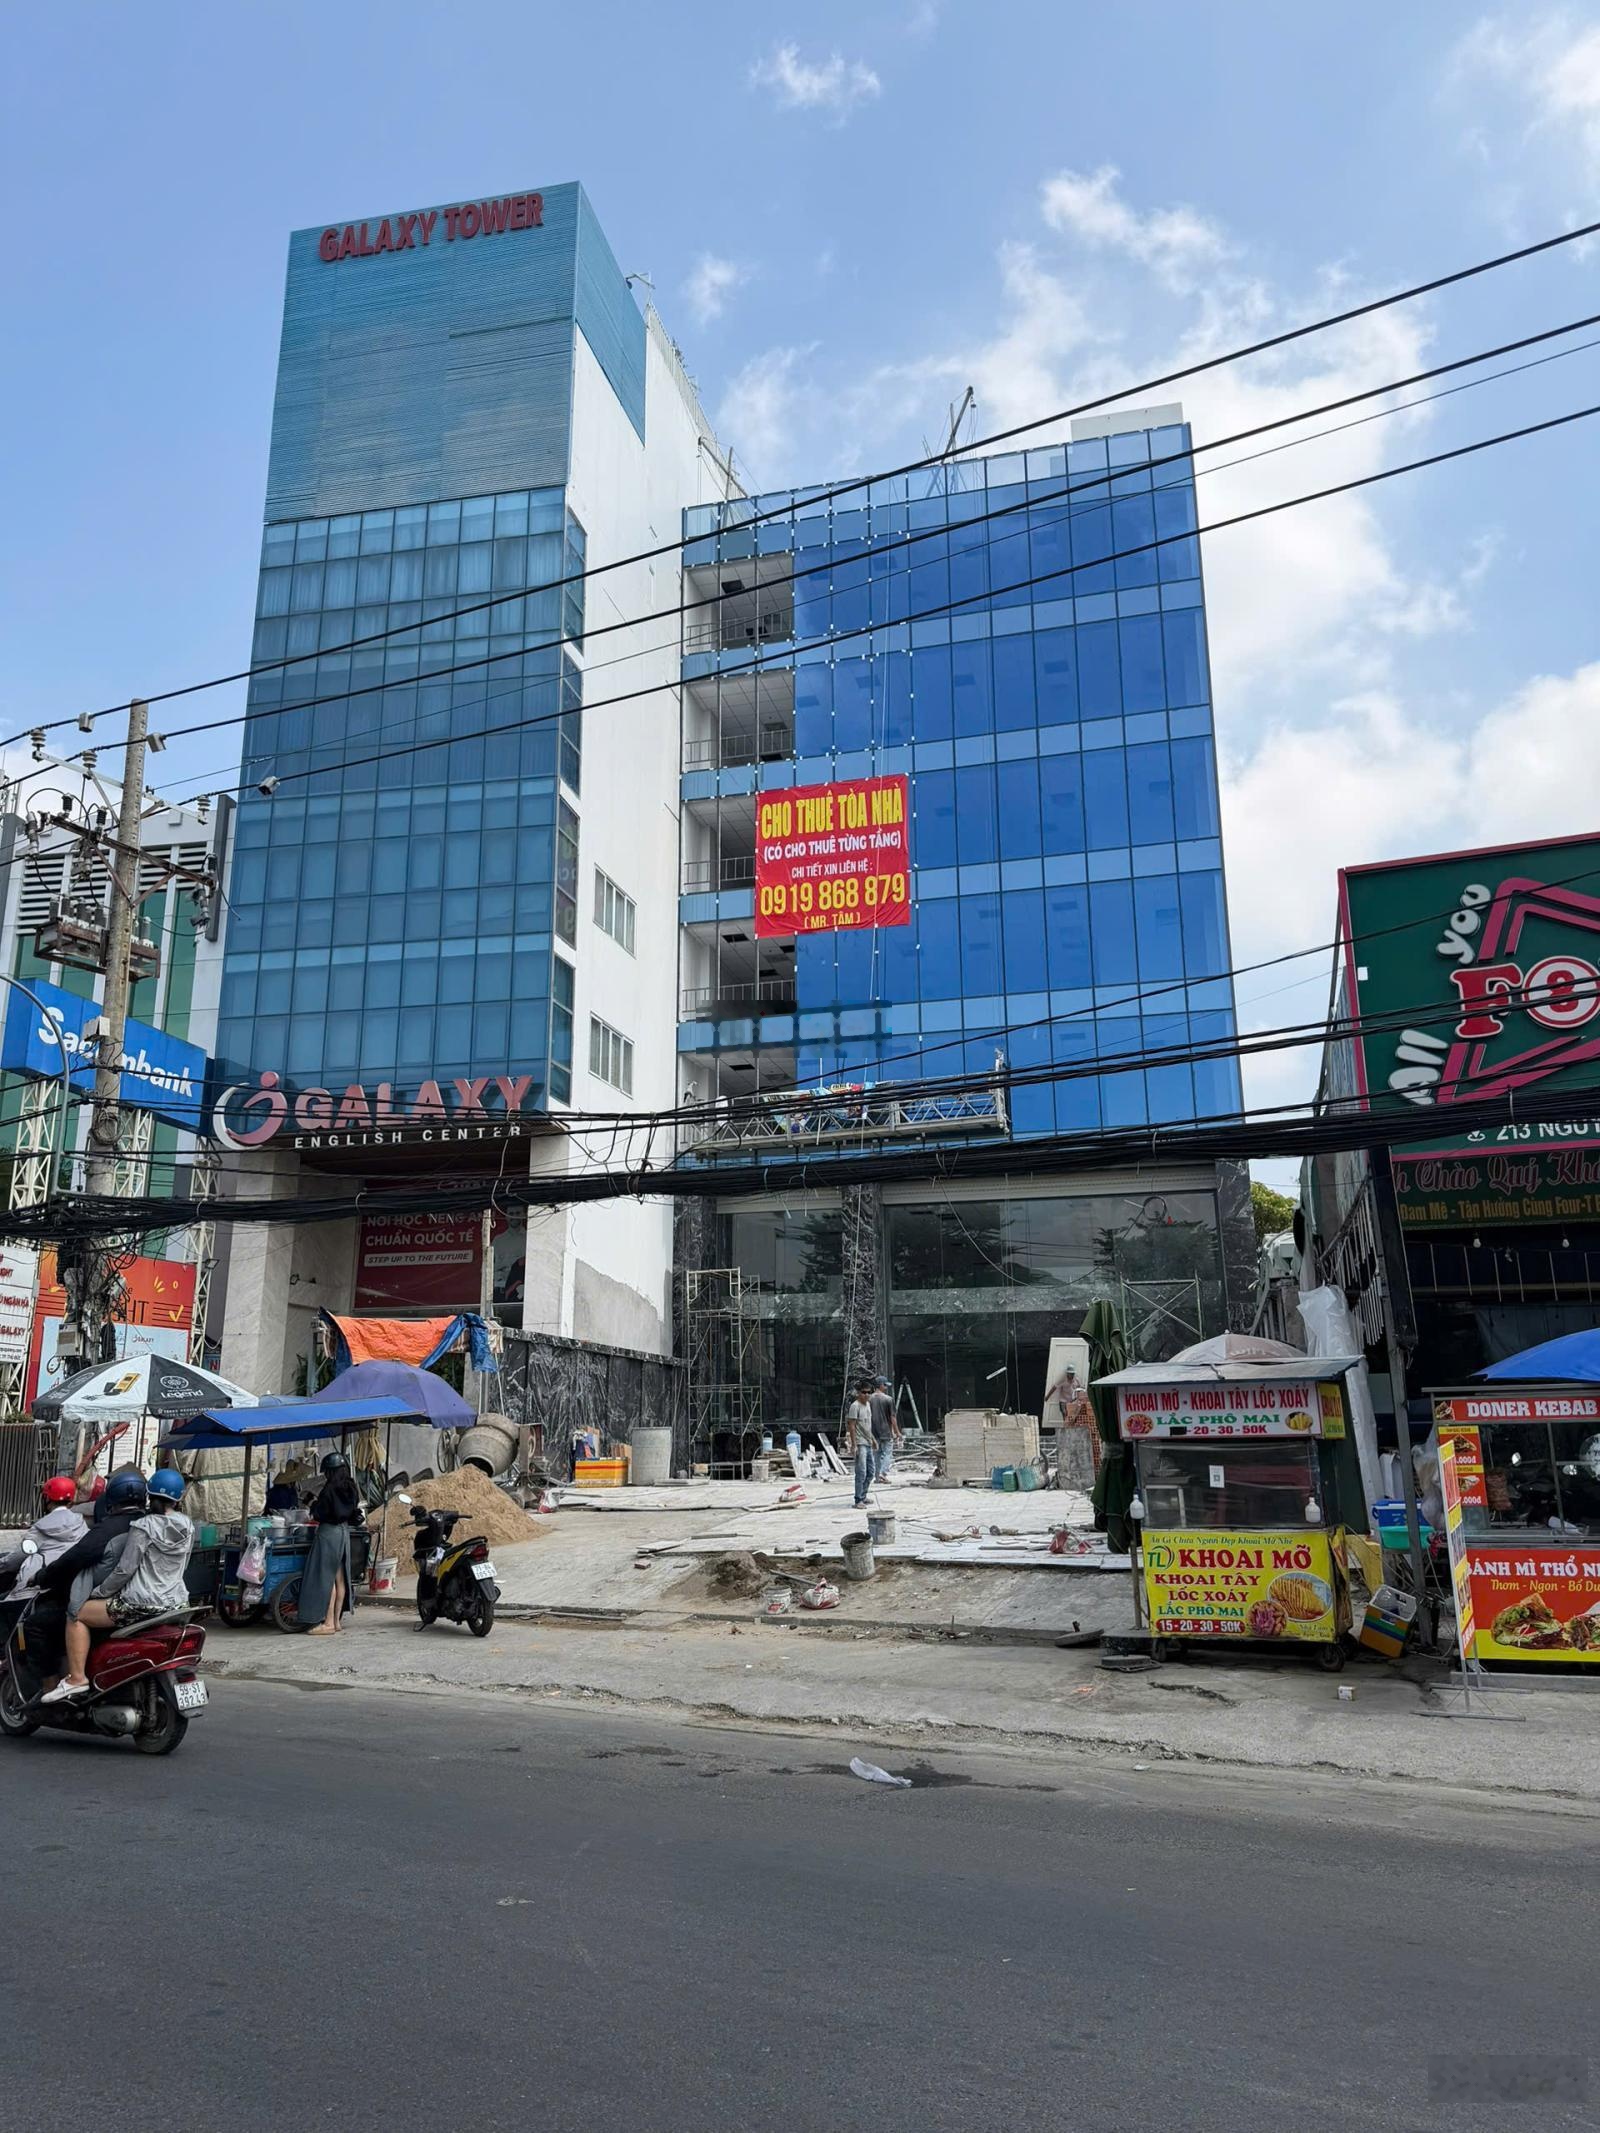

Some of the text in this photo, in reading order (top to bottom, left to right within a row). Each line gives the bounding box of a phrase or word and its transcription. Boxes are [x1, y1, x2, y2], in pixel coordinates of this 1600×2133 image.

[318, 193, 544, 262] GALAXY TOWER
[761, 782, 904, 840] CHO THUÊ TÒA NHÀ
[784, 841, 806, 857] CHO
[808, 835, 836, 856] THUÊ
[838, 832, 867, 853] TỪNG
[791, 866, 805, 879] CHI
[806, 861, 822, 877] TIẾT
[824, 863, 837, 876] XIN
[839, 859, 856, 873] LIÊN
[760, 872, 905, 915] 0919 868 879
[38, 1006, 193, 1098] Sacmbank
[295, 1076, 533, 1130] GALAXY
[294, 1125, 521, 1149] ENGLISH CENTER
[1415, 1158, 1482, 1193] Chào
[366, 1226, 475, 1247] CHUẨN QUỐC TẾ
[368, 1256, 389, 1264] STEP
[417, 1254, 433, 1262] THE
[435, 1253, 469, 1262] FUTURE
[161, 1389, 204, 1399] Legend
[1125, 1392, 1158, 1412] KHOAI
[1161, 1388, 1180, 1411] MỠ
[1190, 1391, 1226, 1411] KHOAI
[1228, 1386, 1250, 1410] TÂY
[1253, 1383, 1276, 1409] LỐC
[1279, 1383, 1310, 1408] XOÁY
[1156, 1412, 1280, 1425] LẮC PHÔ MAI
[1467, 1400, 1598, 1417] DONER KEBAB
[1193, 1426, 1209, 1435] 20
[1218, 1425, 1233, 1434] 30
[1242, 1424, 1268, 1434] 50K
[1147, 1544, 1312, 1570] TL KHOAI MỠ
[1515, 1559, 1536, 1576] MÌ
[1540, 1555, 1578, 1577] THỔ
[1154, 1572, 1261, 1586] KHOAI TÂY
[1529, 1580, 1558, 1593] Ngon
[1169, 1585, 1250, 1602] LỐC XOÁY
[1158, 1603, 1245, 1616] LẮC PHÔ MAI
